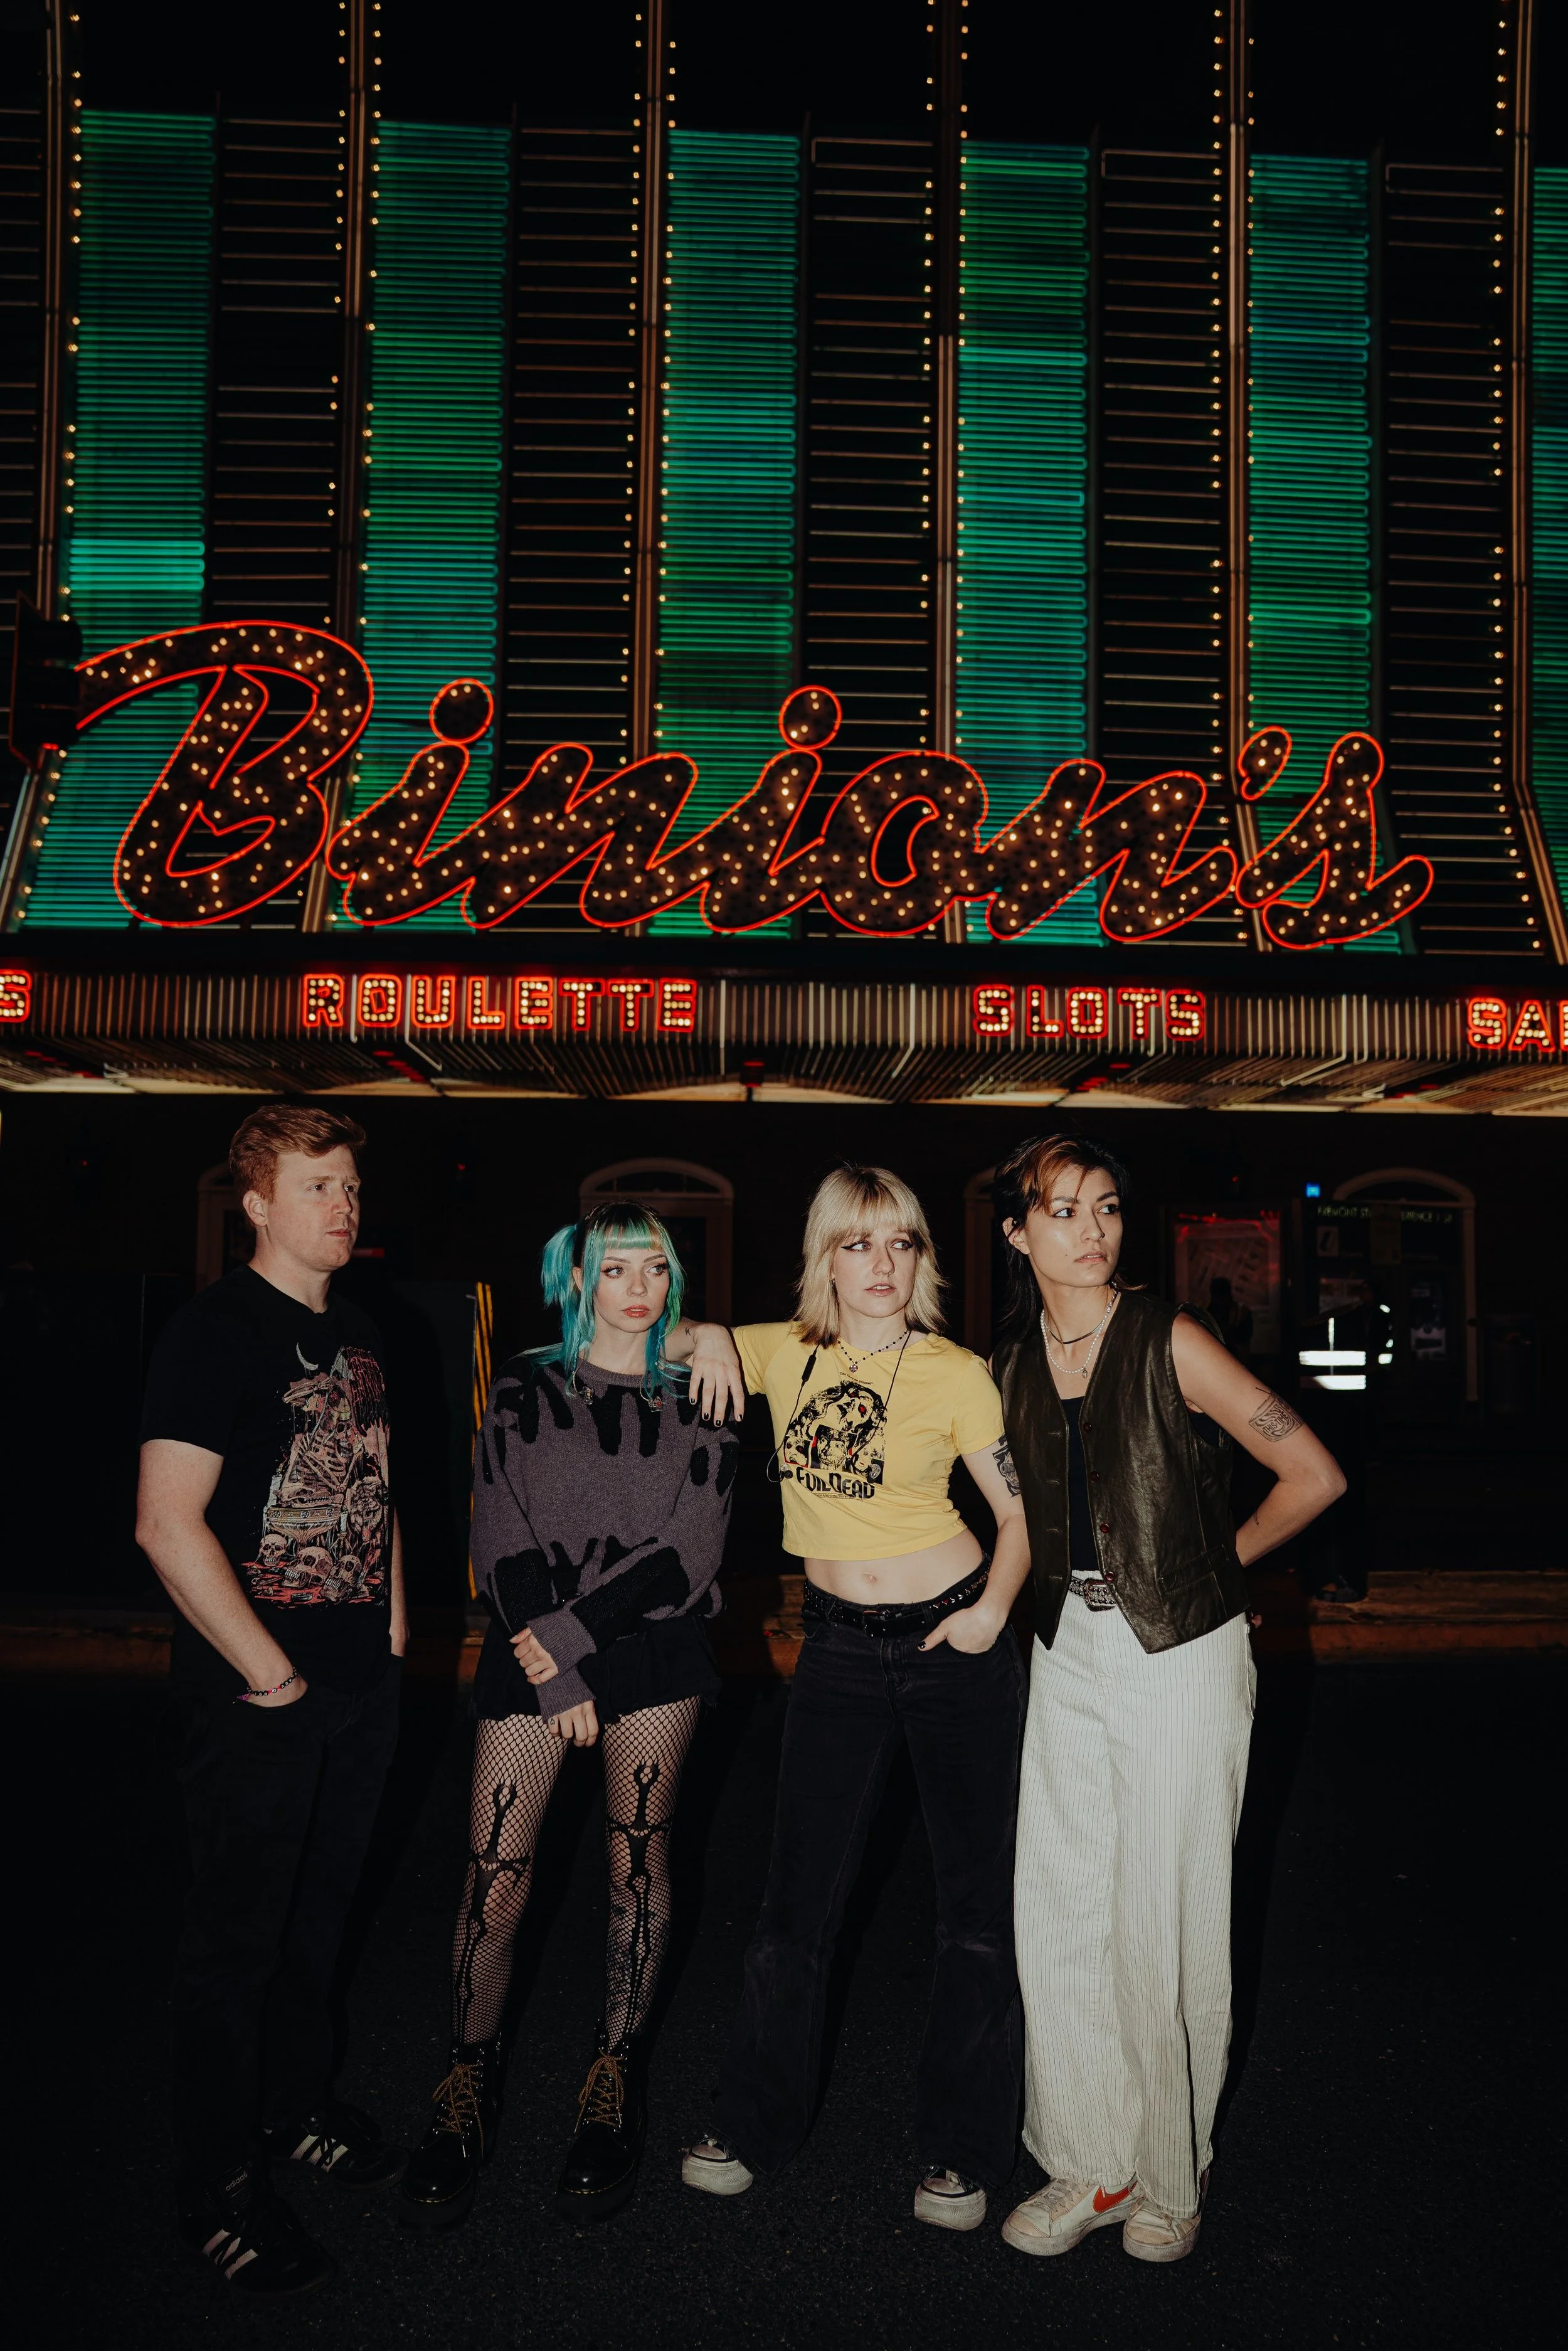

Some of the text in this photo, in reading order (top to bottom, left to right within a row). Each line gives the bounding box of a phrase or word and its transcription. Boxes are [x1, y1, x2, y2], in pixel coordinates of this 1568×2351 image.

[75, 620, 1434, 949] Binion's
[302, 974, 697, 1032] ROULETTE
[973, 984, 1206, 1041] SLOTS
[1263, 1422, 1278, 1433] THIS
[829, 1472, 875, 1499] DEAD
[225, 2170, 248, 2192] adidas
